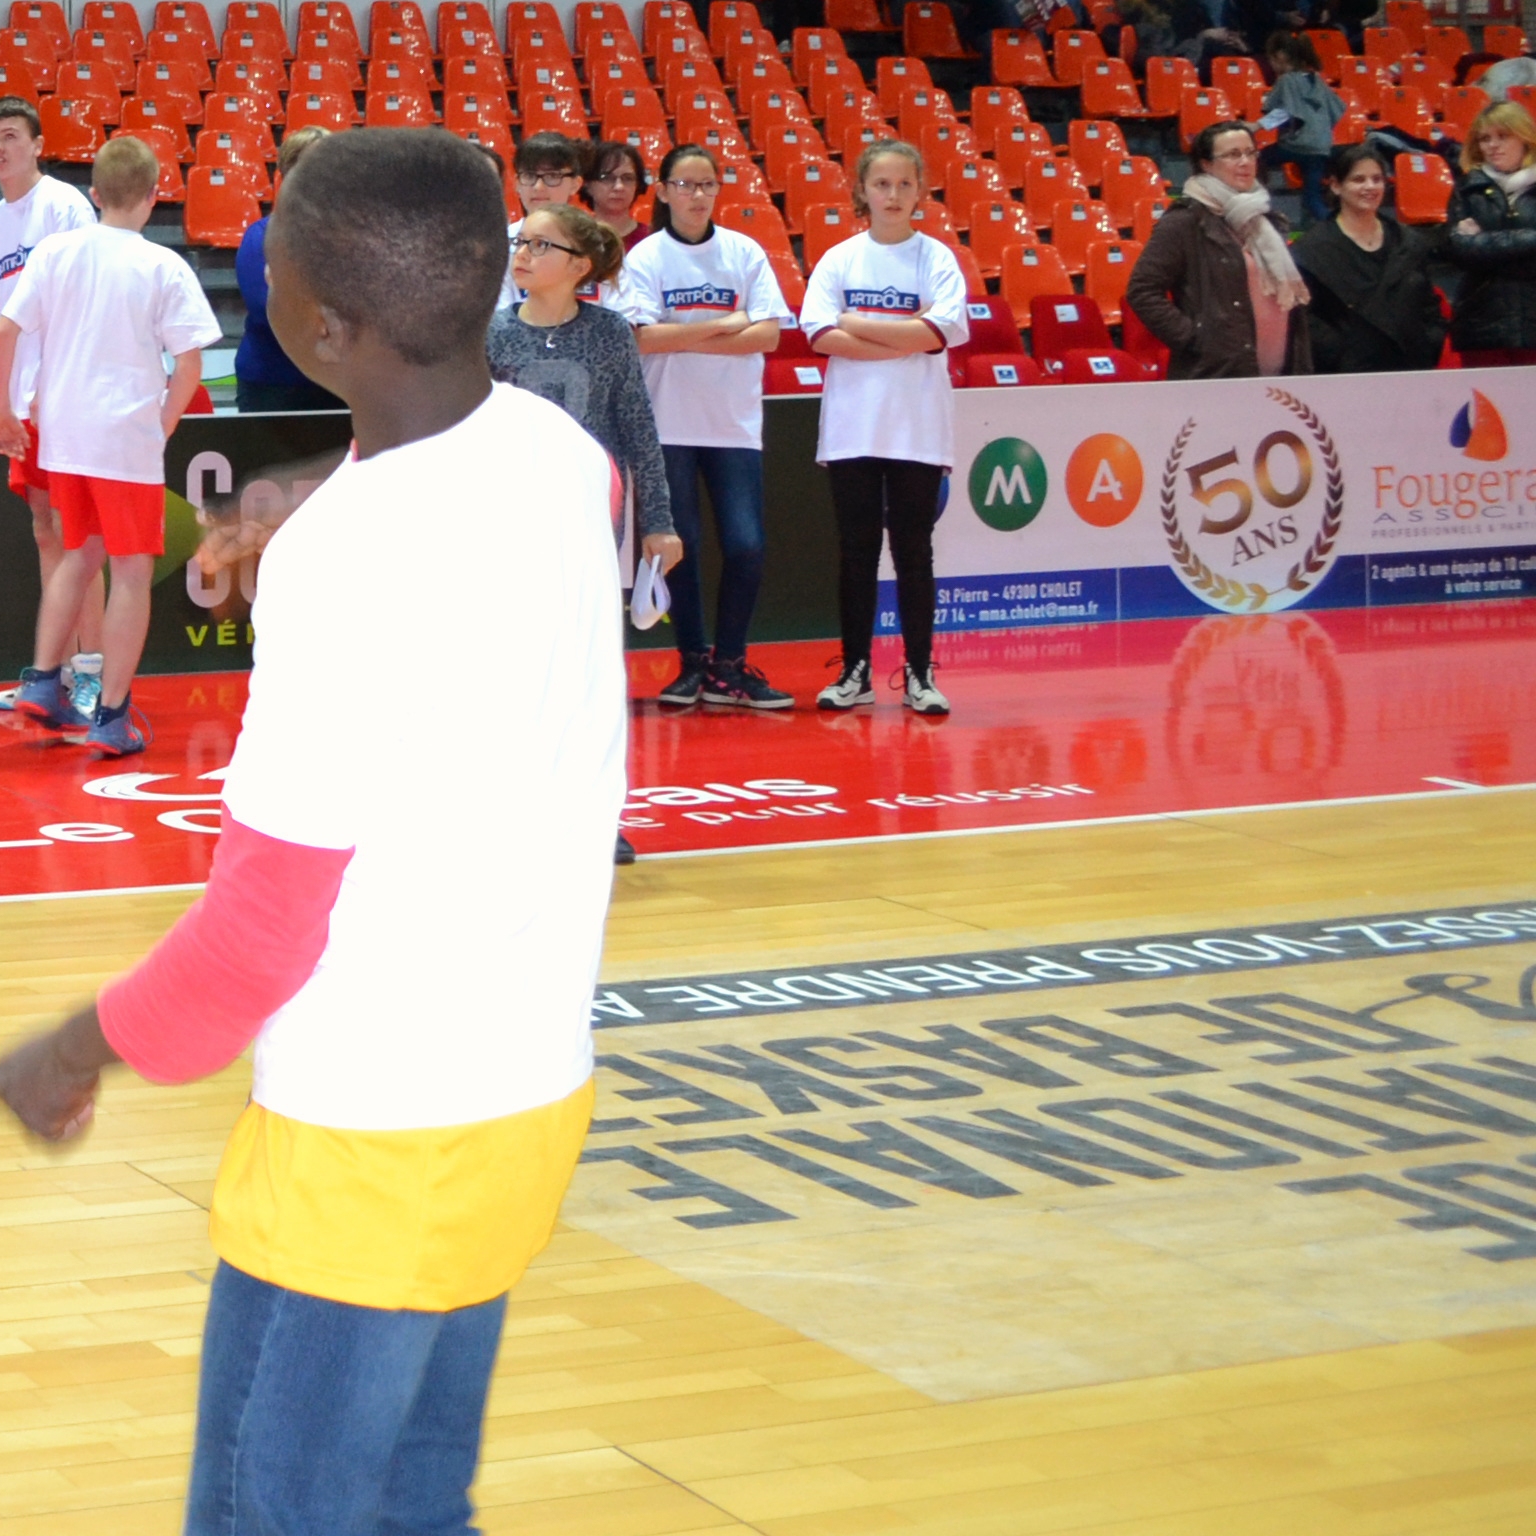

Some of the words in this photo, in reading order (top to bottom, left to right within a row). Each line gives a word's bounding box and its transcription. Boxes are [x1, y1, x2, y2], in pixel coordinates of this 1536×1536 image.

[667, 285, 731, 307] ARTIPÔLE
[849, 289, 915, 311] ARTIPÔLE
[1184, 430, 1313, 535] 50
[1231, 515, 1300, 567] ANS
[953, 586, 989, 603] Pierre
[1002, 582, 1038, 600] 49300
[1039, 580, 1083, 598] CHOLET
[881, 611, 896, 628] 02
[978, 599, 1099, 622] mma.cholet@mma.fr
[681, 802, 848, 826] pour
[866, 783, 1096, 810] réussir
[646, 954, 1095, 1018] PRENDRE
[1118, 992, 1456, 1066] DE
